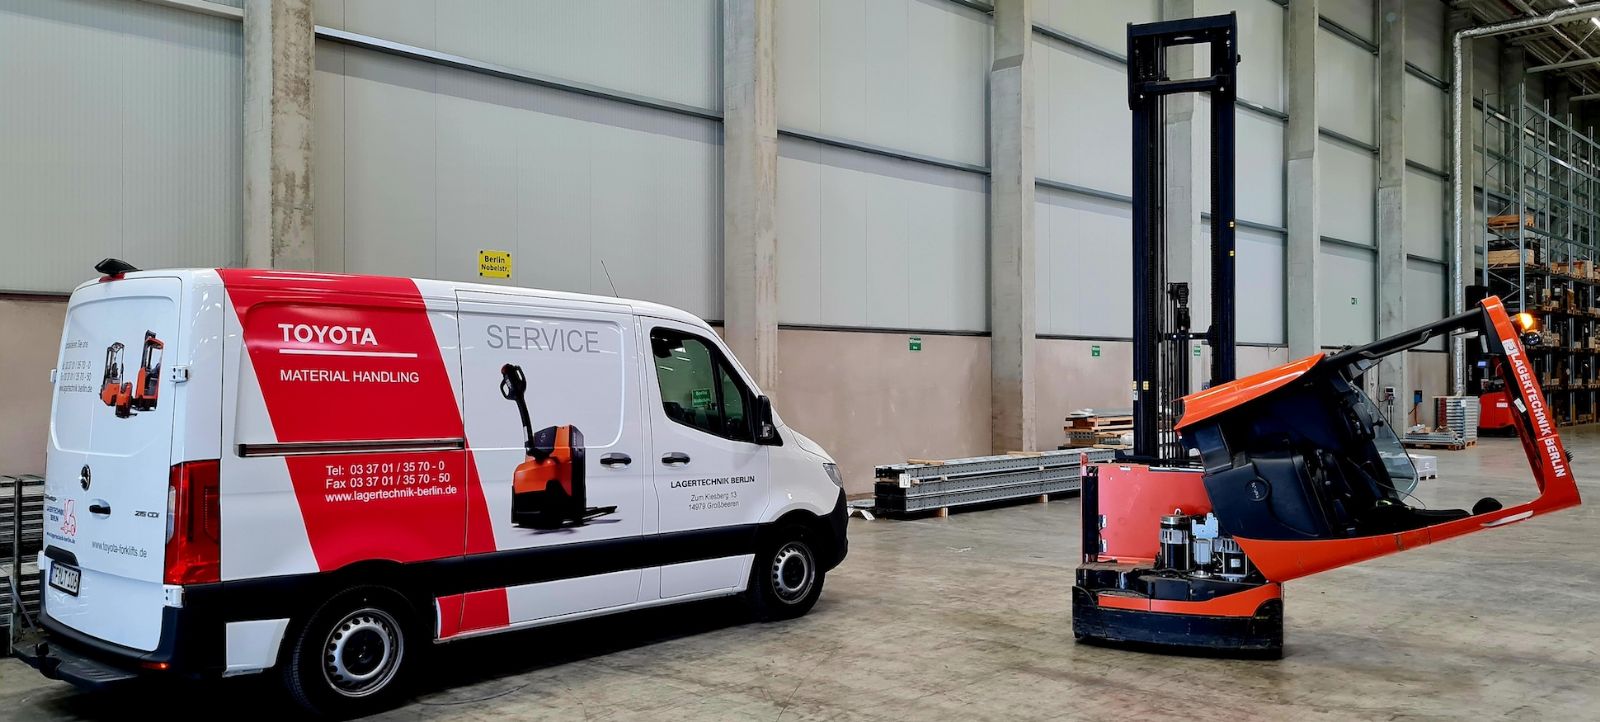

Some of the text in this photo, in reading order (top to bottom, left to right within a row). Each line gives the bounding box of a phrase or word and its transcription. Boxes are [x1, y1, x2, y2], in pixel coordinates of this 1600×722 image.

[481, 263, 509, 272] Nobelstr.
[484, 255, 506, 264] Berlin
[278, 323, 378, 346] TOYOTA
[486, 324, 601, 354] SERVICE
[280, 369, 420, 383] MATERIAL HANDLING
[1509, 352, 1566, 478] LAGERTECHNIK BERLIN
[326, 465, 345, 476] Tel:
[350, 464, 364, 475] 03
[366, 463, 379, 474] 37
[381, 463, 394, 473] 01
[403, 462, 416, 472] 35
[418, 461, 430, 472] 70
[438, 460, 445, 471] 0
[325, 478, 347, 489] Fax
[350, 477, 364, 488] 03
[366, 476, 379, 487] 37
[381, 475, 394, 486] 01
[403, 474, 416, 485] 35
[418, 473, 430, 484] 70
[438, 472, 451, 483] 50
[670, 475, 755, 489] LAGERTECHNIK BERLIN
[325, 485, 457, 502] www.lagertechnik-berlin.de
[690, 494, 704, 502] Zum
[92, 541, 148, 558] www.toyota-forklifts.de
